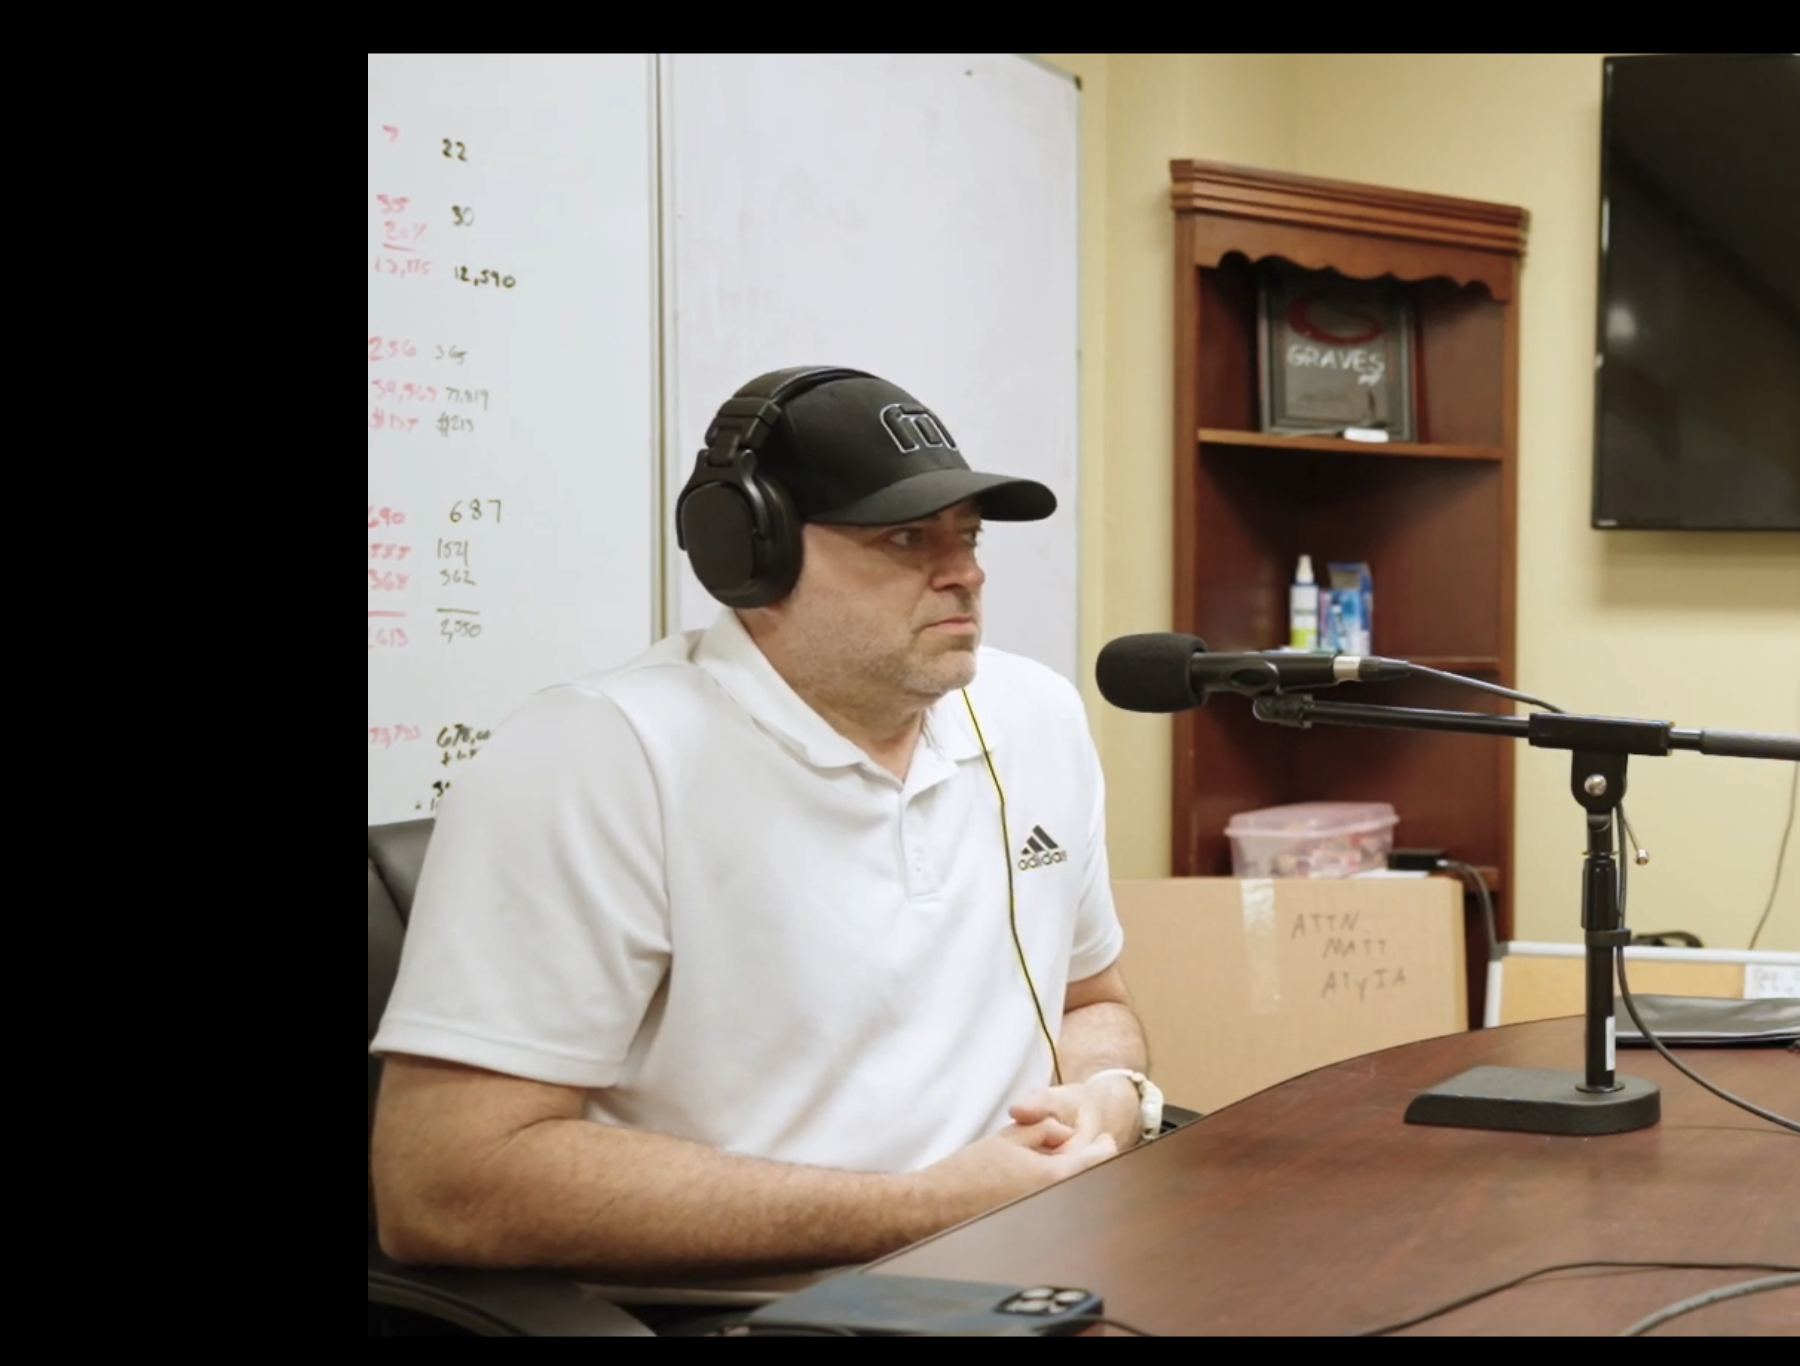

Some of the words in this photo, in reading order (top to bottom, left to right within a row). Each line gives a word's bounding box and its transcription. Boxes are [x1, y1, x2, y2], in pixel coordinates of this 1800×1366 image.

[441, 138, 468, 162] 22
[451, 204, 475, 227] 30
[454, 265, 517, 288] 12,590
[1287, 344, 1386, 376] GRAVES
[449, 498, 501, 523] 687
[1017, 849, 1067, 871] adidas
[1290, 911, 1360, 940] ATTN
[1321, 936, 1387, 960] MATT
